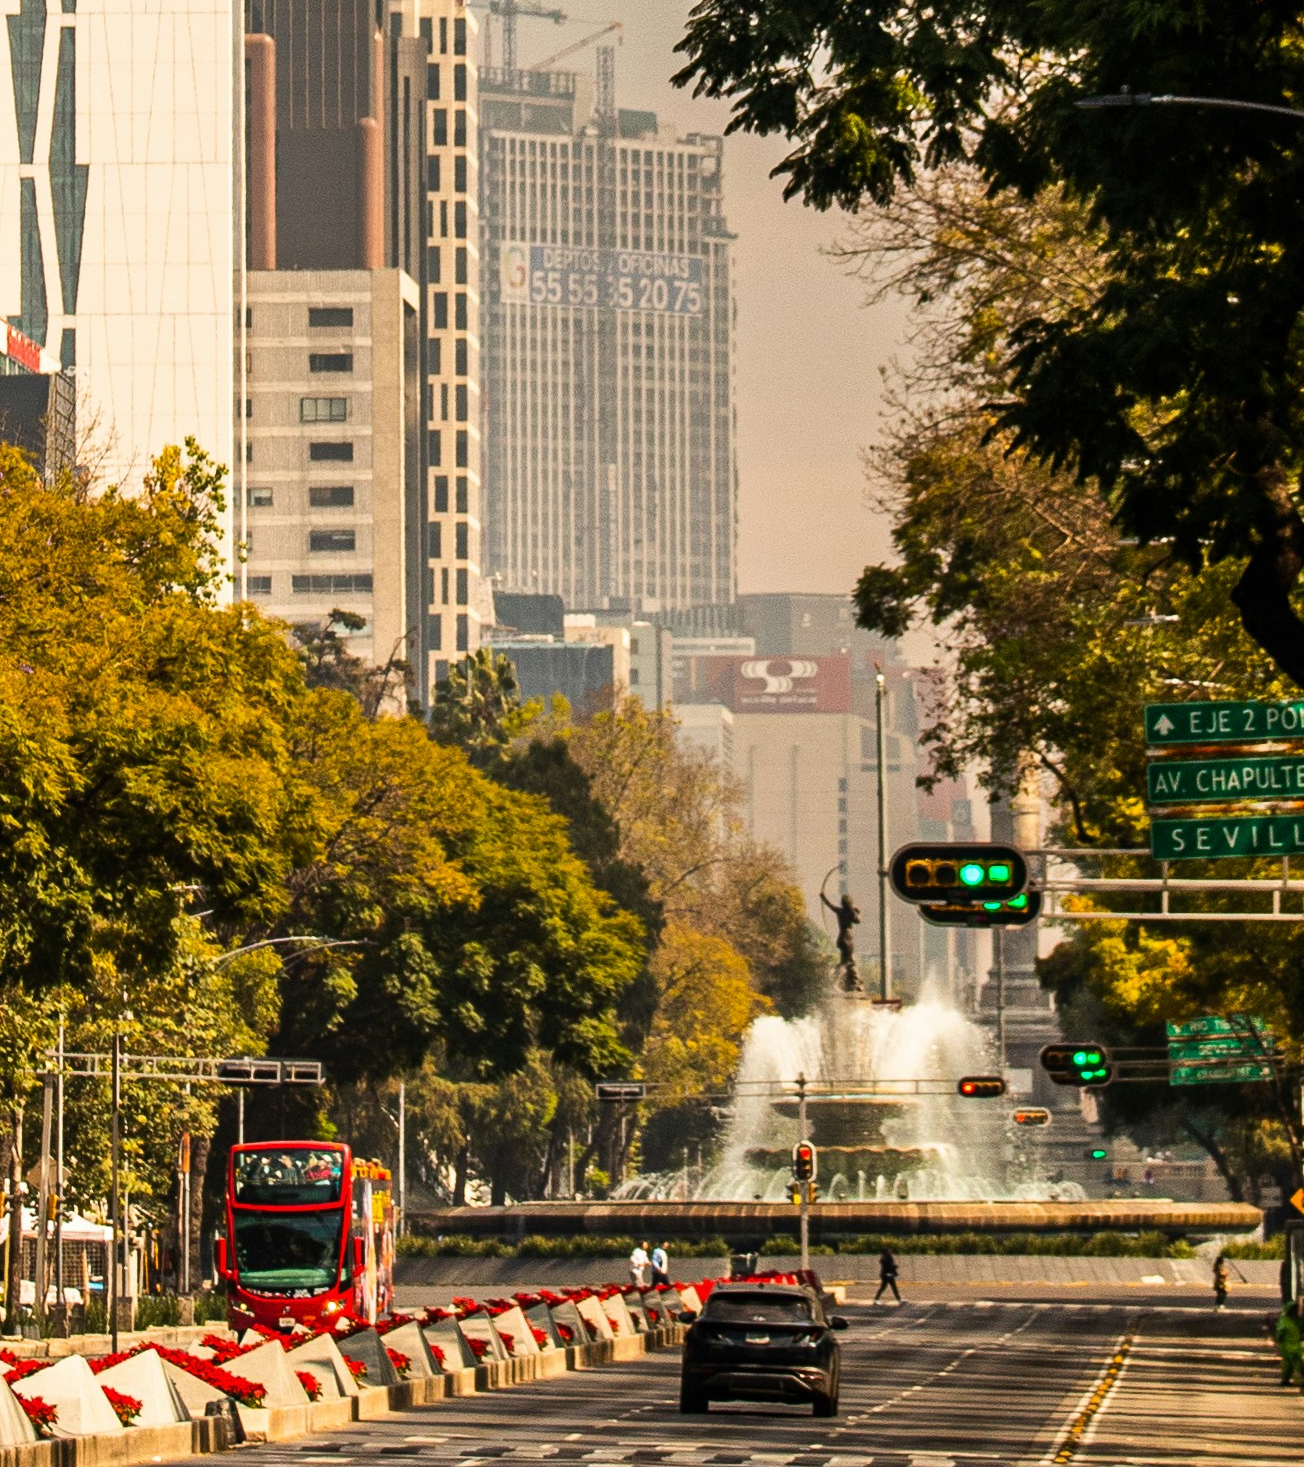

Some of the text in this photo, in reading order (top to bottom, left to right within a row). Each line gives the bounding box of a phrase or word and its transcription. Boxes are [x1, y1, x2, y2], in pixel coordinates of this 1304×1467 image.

[617, 254, 691, 278] OFICINAS
[532, 270, 562, 302] 55
[568, 273, 598, 304] 55
[639, 279, 668, 310] 20
[673, 281, 701, 313] 75
[1190, 710, 1231, 733] EJE
[1243, 710, 1255, 731] 2
[1155, 771, 1187, 793] AV.
